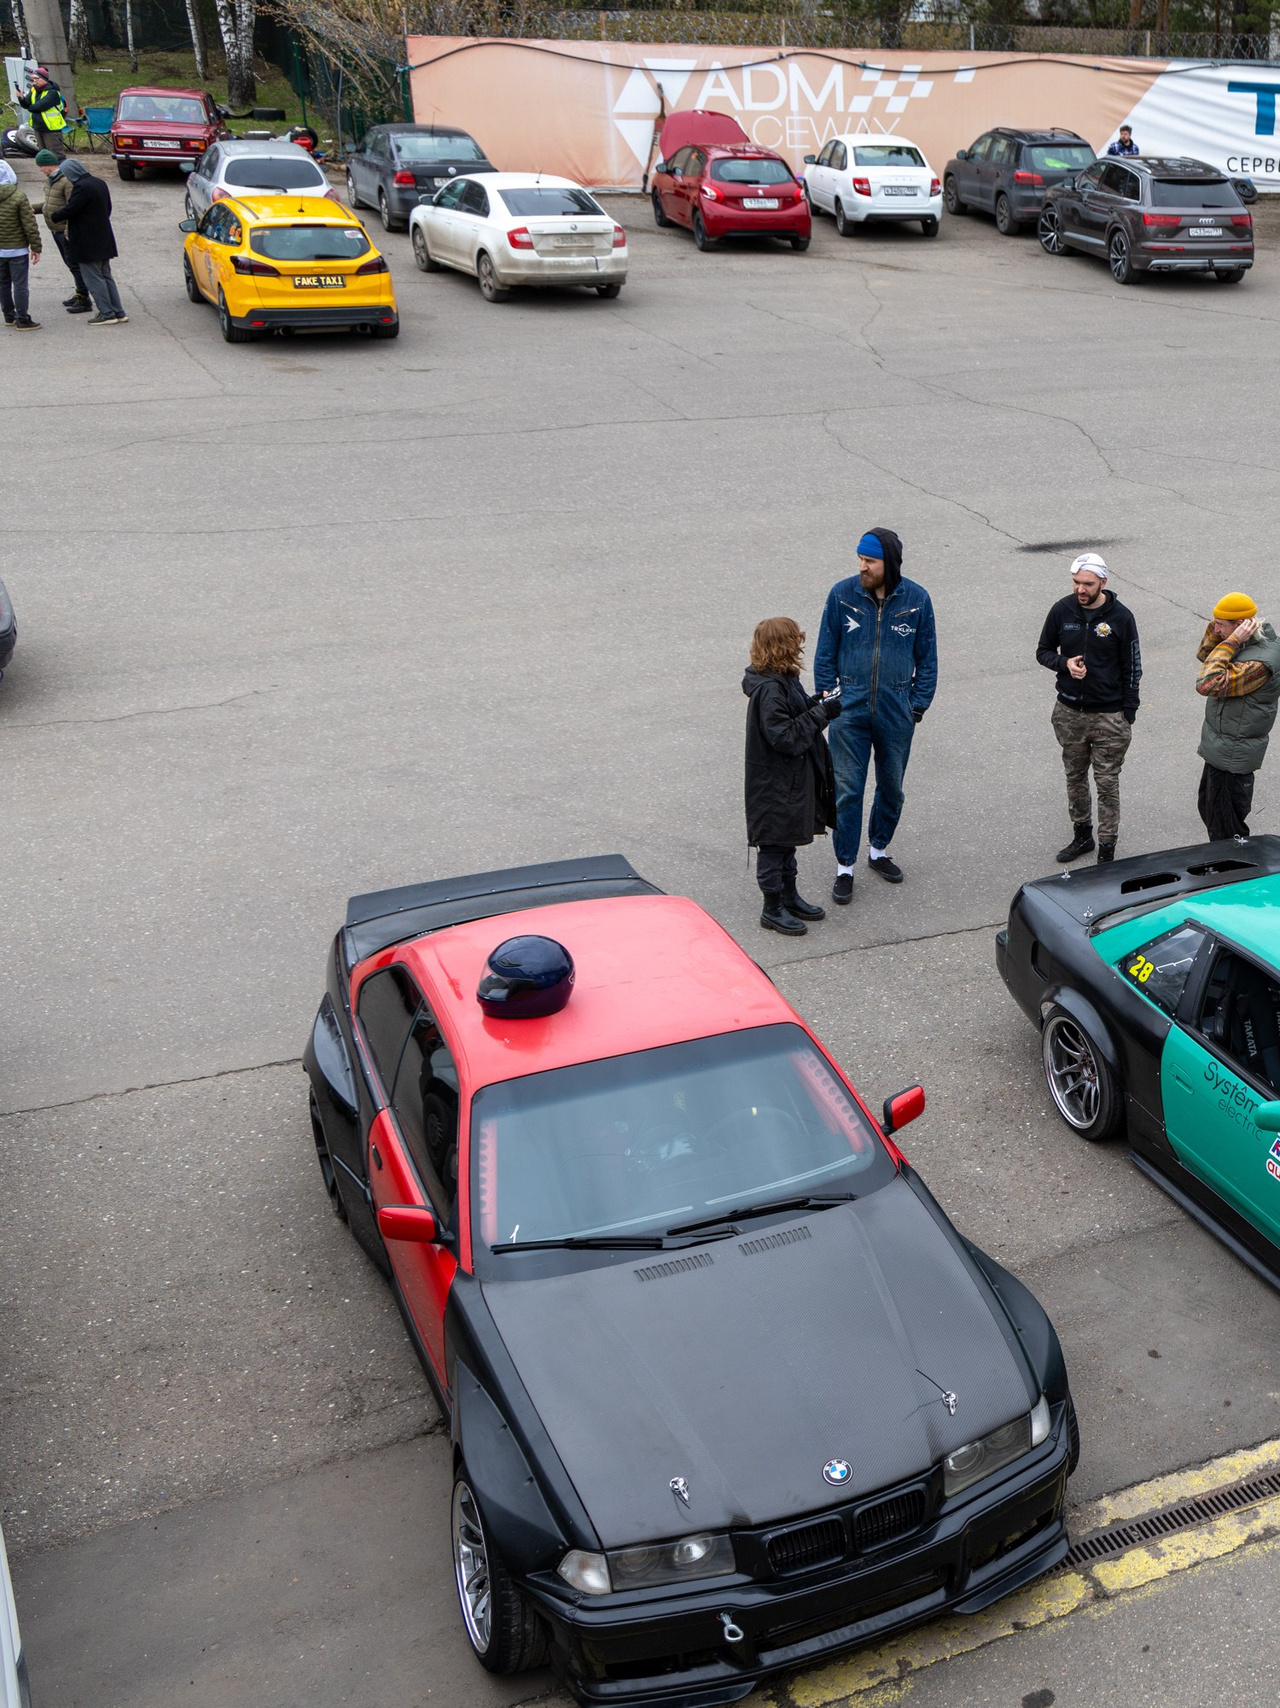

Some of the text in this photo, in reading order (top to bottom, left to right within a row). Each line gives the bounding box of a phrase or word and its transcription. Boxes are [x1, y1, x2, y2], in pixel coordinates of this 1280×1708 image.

[695, 61, 844, 112] ADM
[294, 275, 344, 287] FAKE TAXI
[1129, 955, 1154, 984] 28
[1244, 1019, 1257, 1057] TAKATA
[1203, 1061, 1259, 1114] Systêm
[1218, 1097, 1264, 1142] electric
